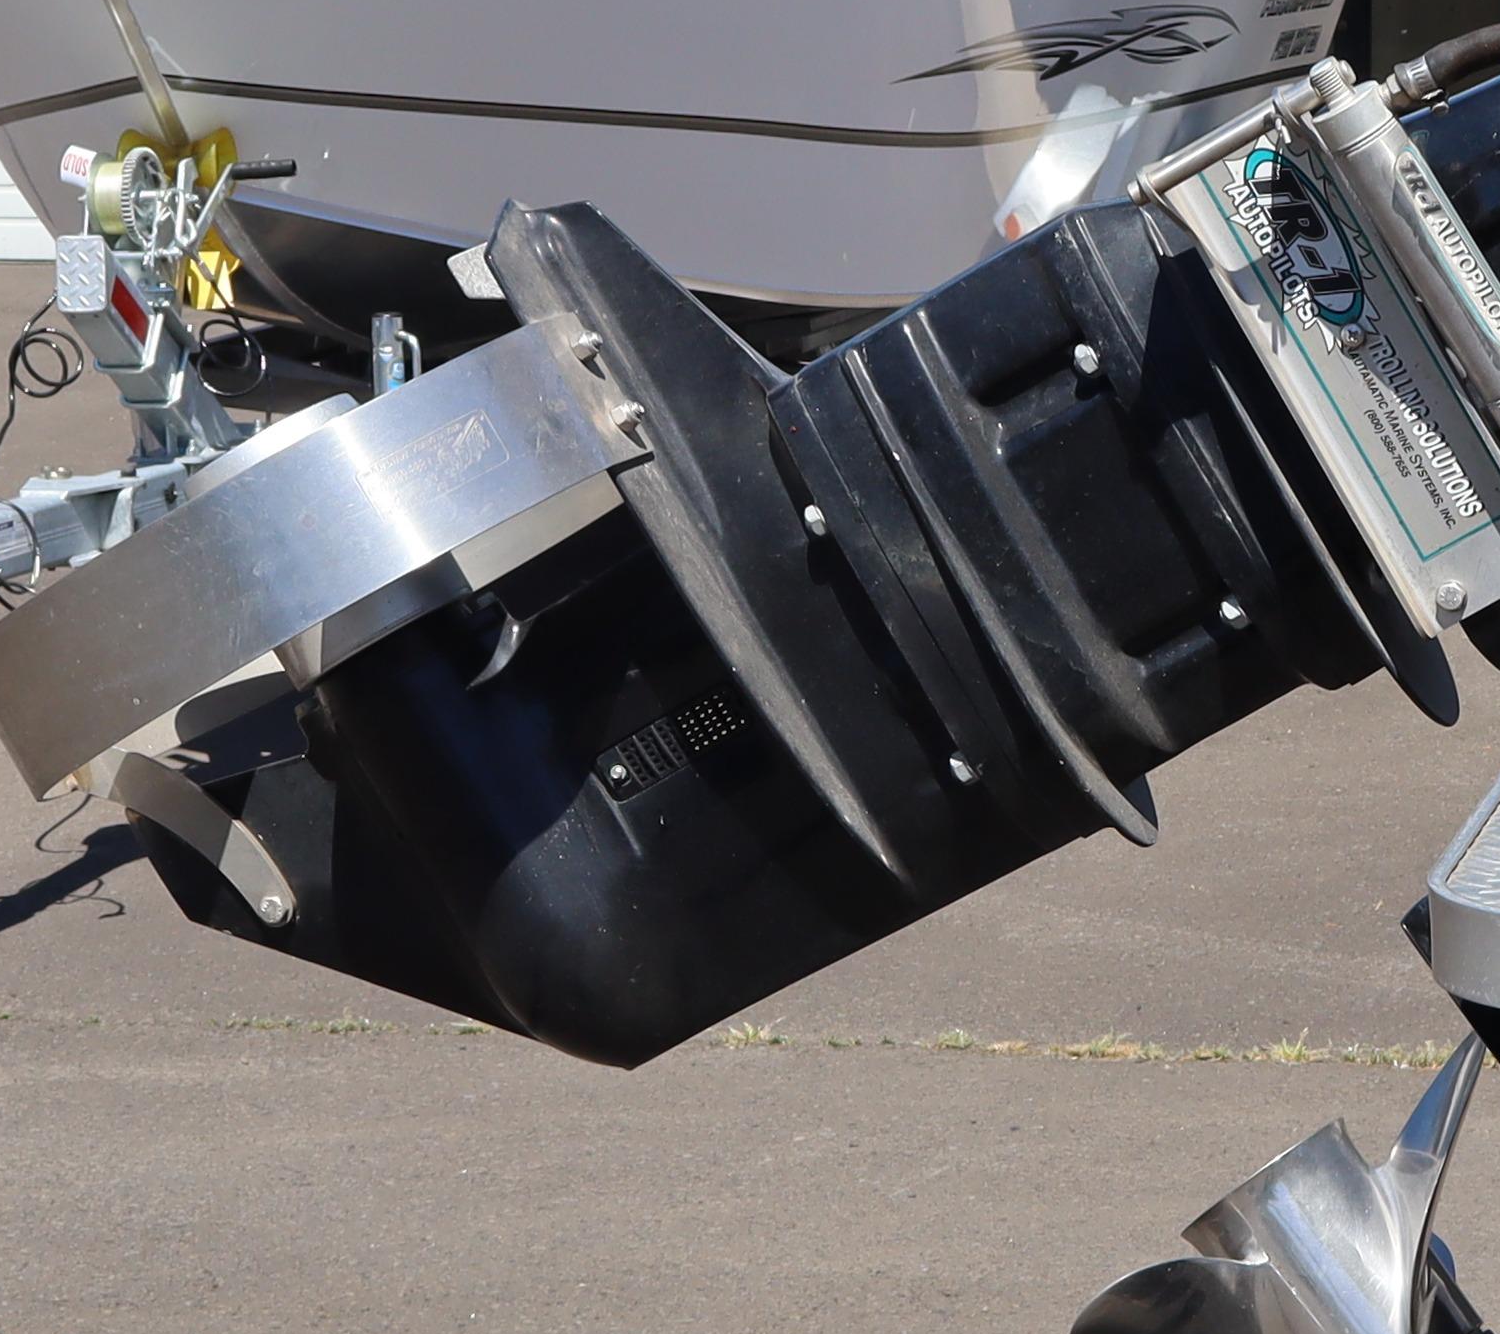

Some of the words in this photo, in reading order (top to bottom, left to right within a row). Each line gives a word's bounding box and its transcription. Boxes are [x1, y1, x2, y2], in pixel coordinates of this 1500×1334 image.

[1249, 168, 1362, 295] TR-1
[1400, 159, 1442, 217] TR-1
[1224, 182, 1319, 322] AUTOPILOTS
[1364, 409, 1386, 435] (800)
[1368, 334, 1430, 423] TROLLING
[1412, 421, 1484, 518] SOLUTIONS
[1384, 406, 1415, 454] MARINE
[1409, 453, 1445, 508] SYSTEMS,
[1439, 506, 1457, 529] INC.
